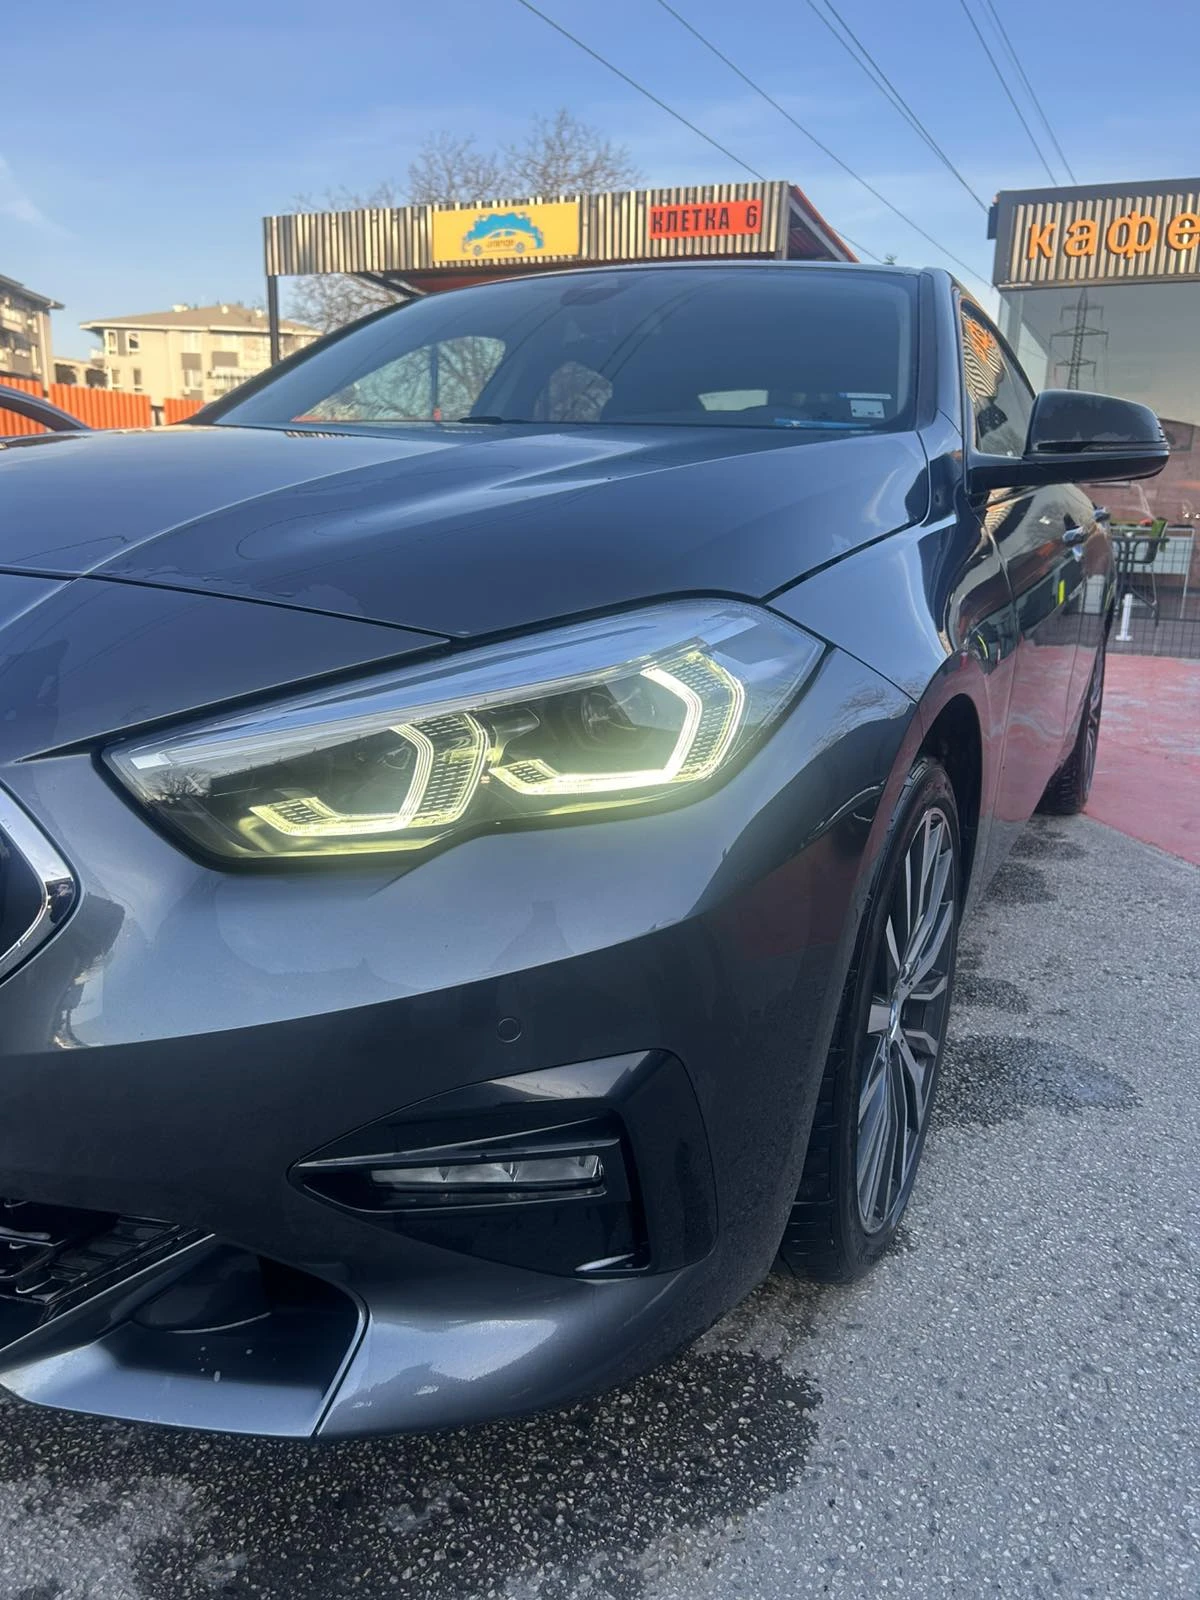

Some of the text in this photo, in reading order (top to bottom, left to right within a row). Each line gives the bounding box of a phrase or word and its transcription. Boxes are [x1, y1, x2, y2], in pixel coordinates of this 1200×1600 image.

[651, 204, 759, 234] КЛЕТКА 6
[1027, 209, 1200, 260] кафе
